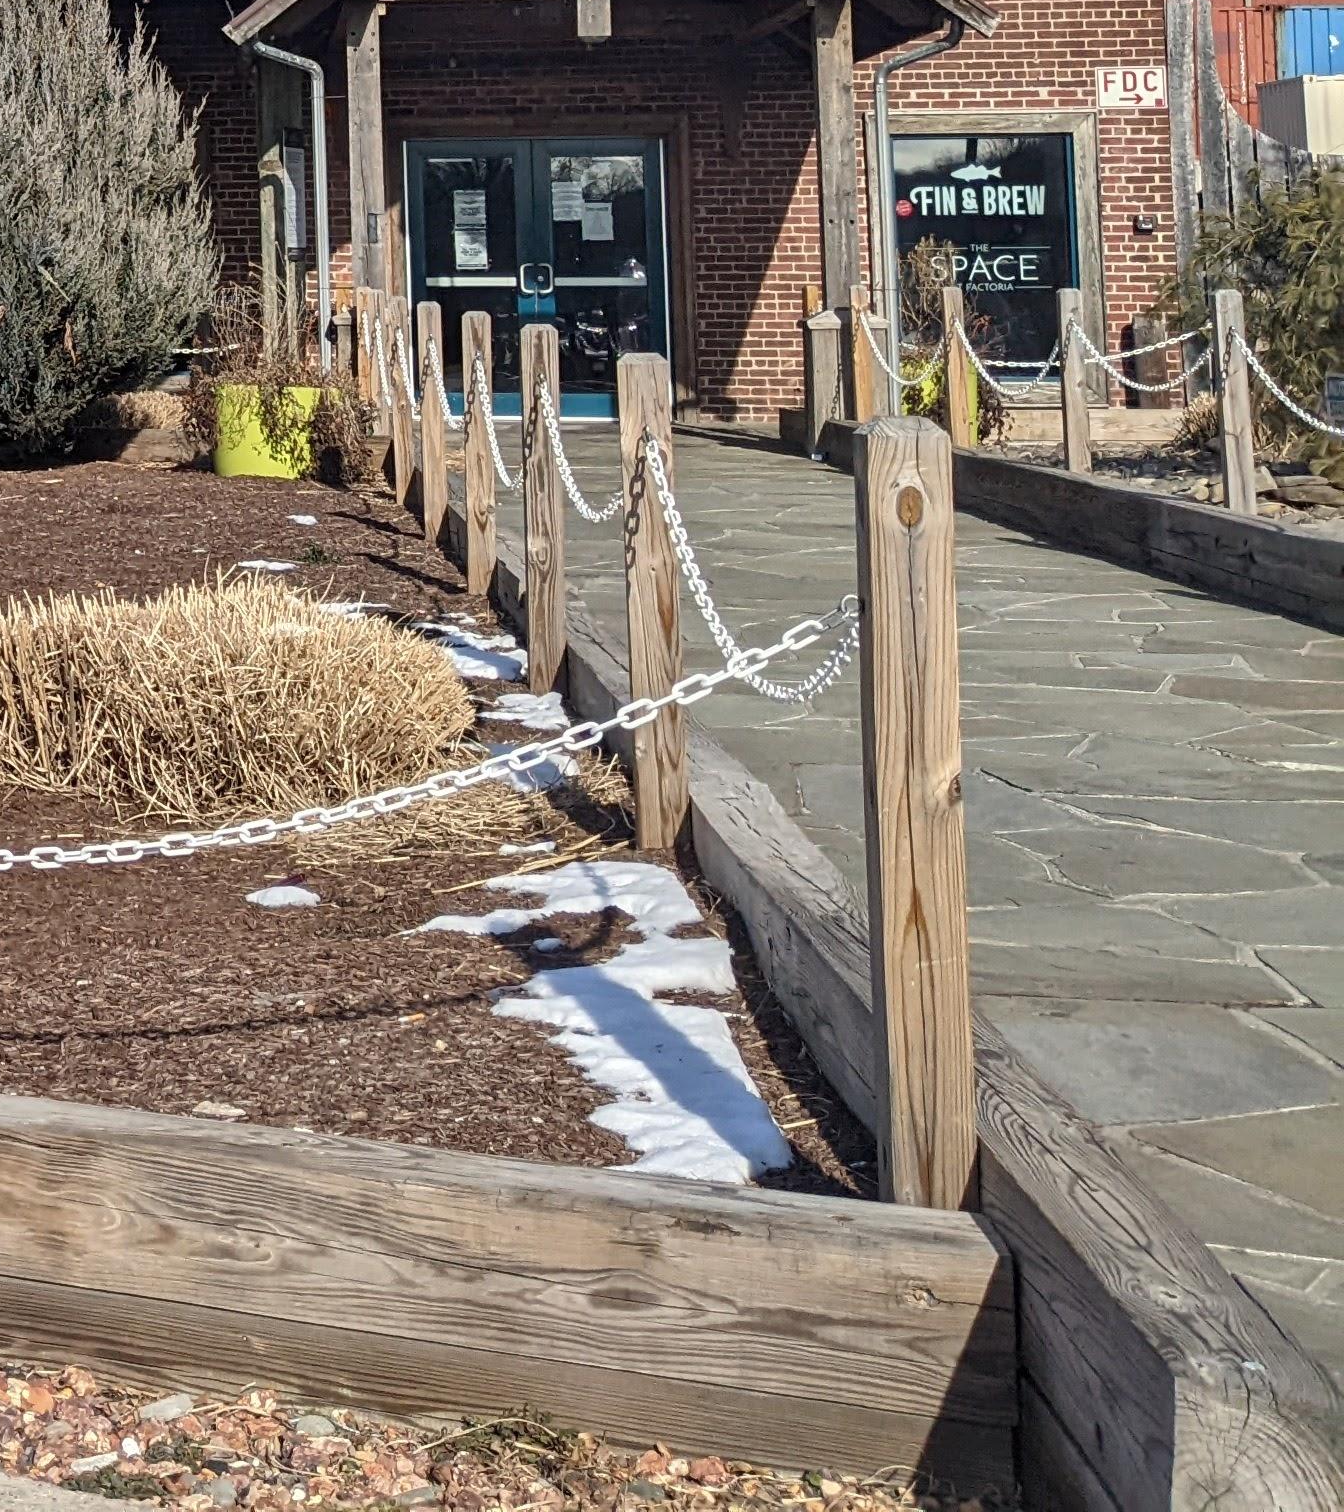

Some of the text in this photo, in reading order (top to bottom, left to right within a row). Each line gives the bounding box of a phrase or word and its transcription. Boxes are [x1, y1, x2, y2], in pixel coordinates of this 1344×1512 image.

[1103, 71, 1158, 92] FDC
[909, 185, 957, 216] FIN
[961, 187, 978, 214] &
[982, 185, 1045, 216] BREW
[969, 243, 991, 253] THE
[931, 254, 1040, 282] SPACE
[965, 282, 1015, 292] FACTORIA
